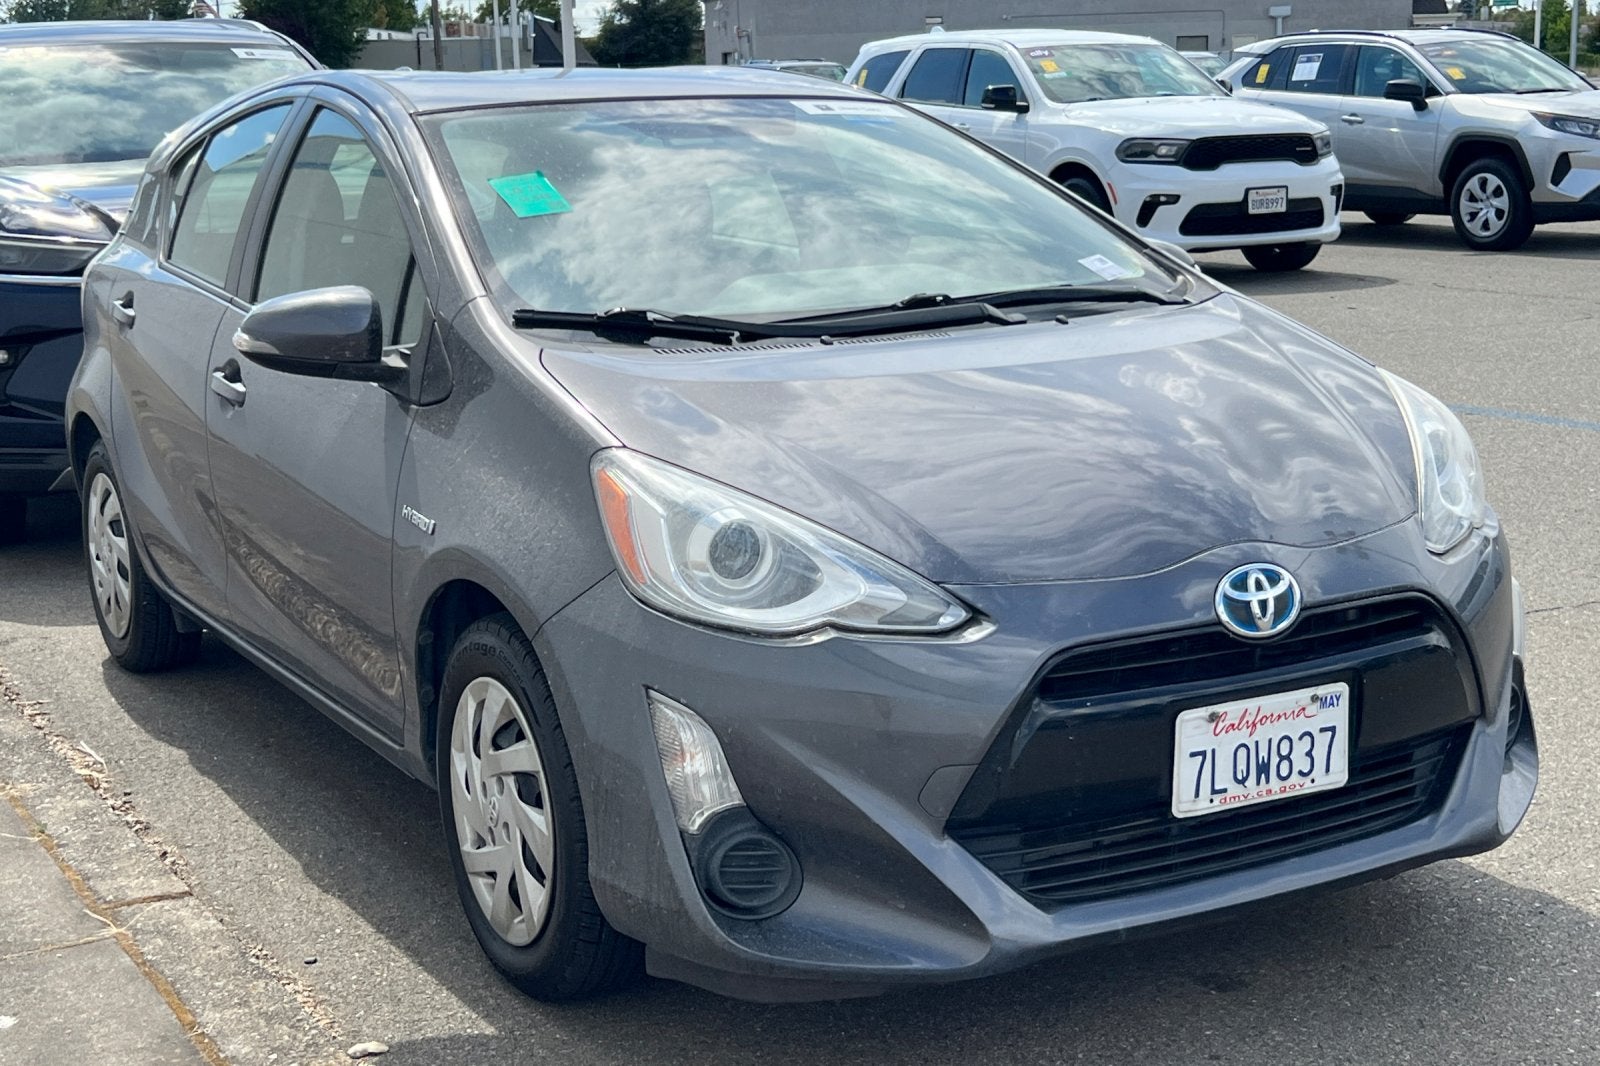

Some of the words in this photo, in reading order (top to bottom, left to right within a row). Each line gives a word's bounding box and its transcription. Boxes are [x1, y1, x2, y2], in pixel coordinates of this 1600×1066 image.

[1319, 693, 1342, 710] MAY
[1213, 706, 1317, 737] California
[1189, 725, 1337, 799] 7LQW837
[1219, 781, 1306, 804] dmv.ca.gov
